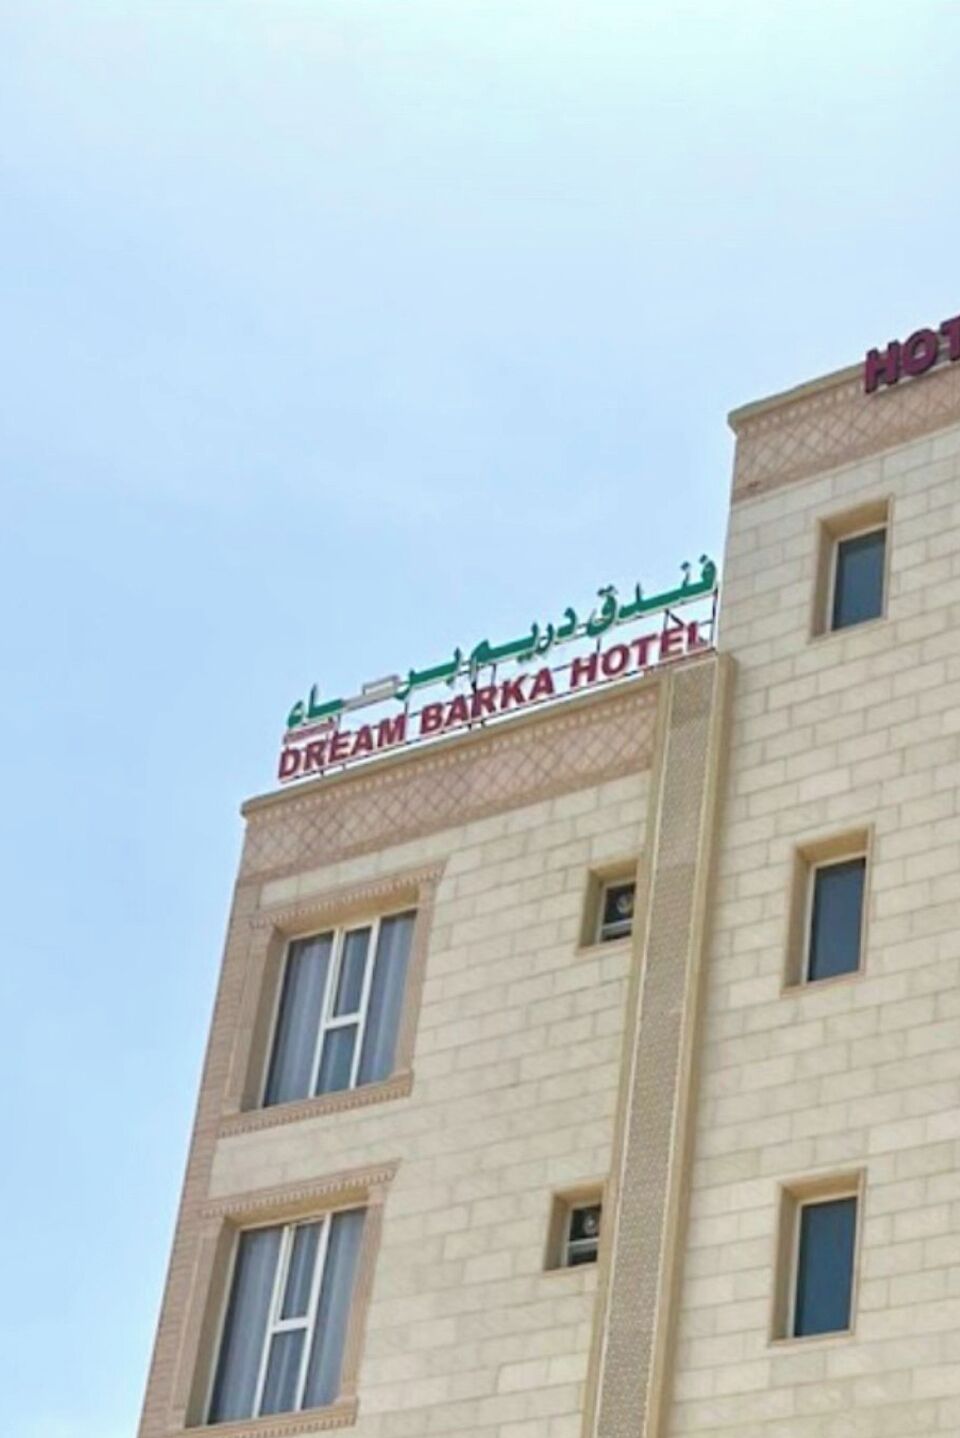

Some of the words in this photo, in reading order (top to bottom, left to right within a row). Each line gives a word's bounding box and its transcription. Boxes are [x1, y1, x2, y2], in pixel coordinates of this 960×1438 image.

[585, 553, 717, 638] فندق
[278, 714, 407, 780] DREAM
[420, 667, 556, 738] BARKA
[569, 621, 712, 688] HOTEL
